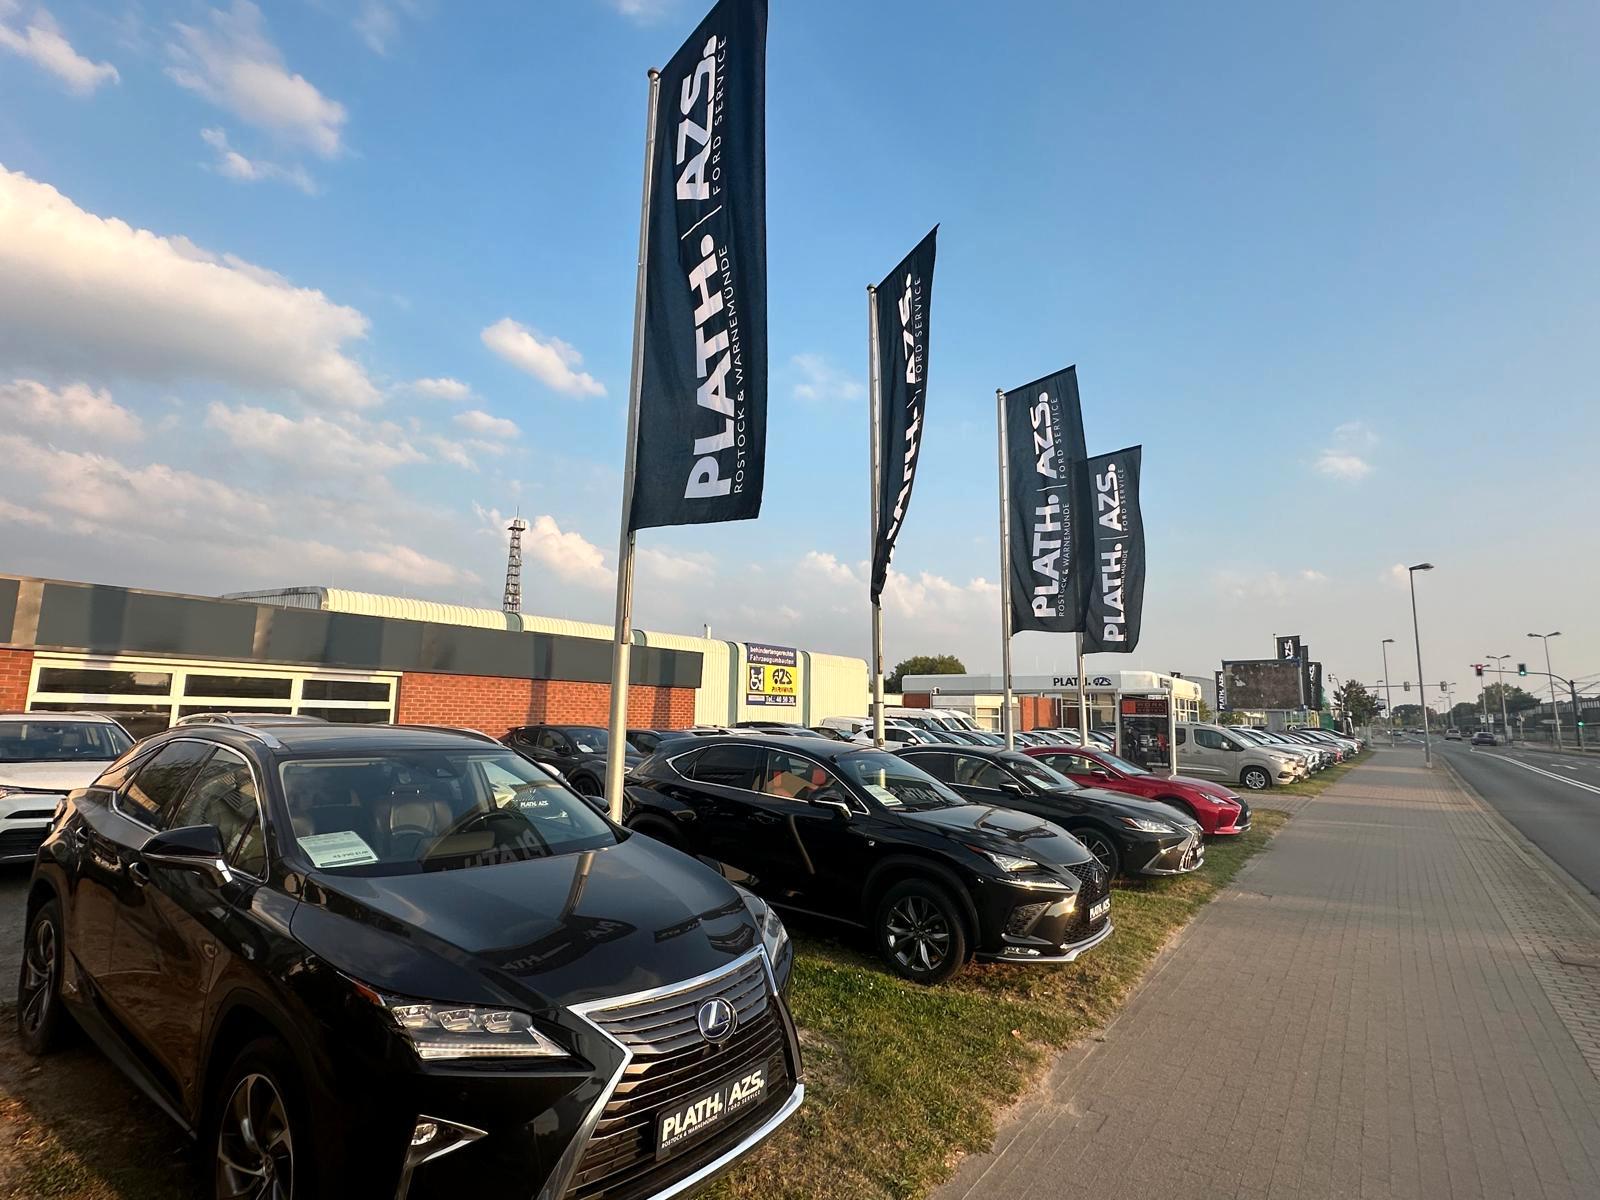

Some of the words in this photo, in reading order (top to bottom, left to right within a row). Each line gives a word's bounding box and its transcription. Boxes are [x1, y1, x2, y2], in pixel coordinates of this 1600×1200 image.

[676, 35, 717, 200] AZS.
[714, 36, 727, 126] SERVICE
[712, 135, 722, 195] FORD
[718, 244, 744, 385] WARNEMÜNDE
[914, 277, 923, 338] SERVICE
[684, 234, 735, 499] PLATH.
[738, 390, 744, 401] &
[733, 408, 746, 493] ROSTOCK
[1029, 392, 1057, 479] AZS.
[1051, 397, 1062, 445] SERVICE
[1057, 450, 1066, 479] FORD
[1096, 463, 1122, 531] AZS.
[1118, 468, 1126, 504] SERVICE
[1031, 494, 1061, 617] PLATH.
[1101, 543, 1125, 641] PLATH.
[1058, 575, 1069, 617] ROSTOCK
[662, 1091, 723, 1142] PLATH.
[728, 1069, 765, 1106] AZS.
